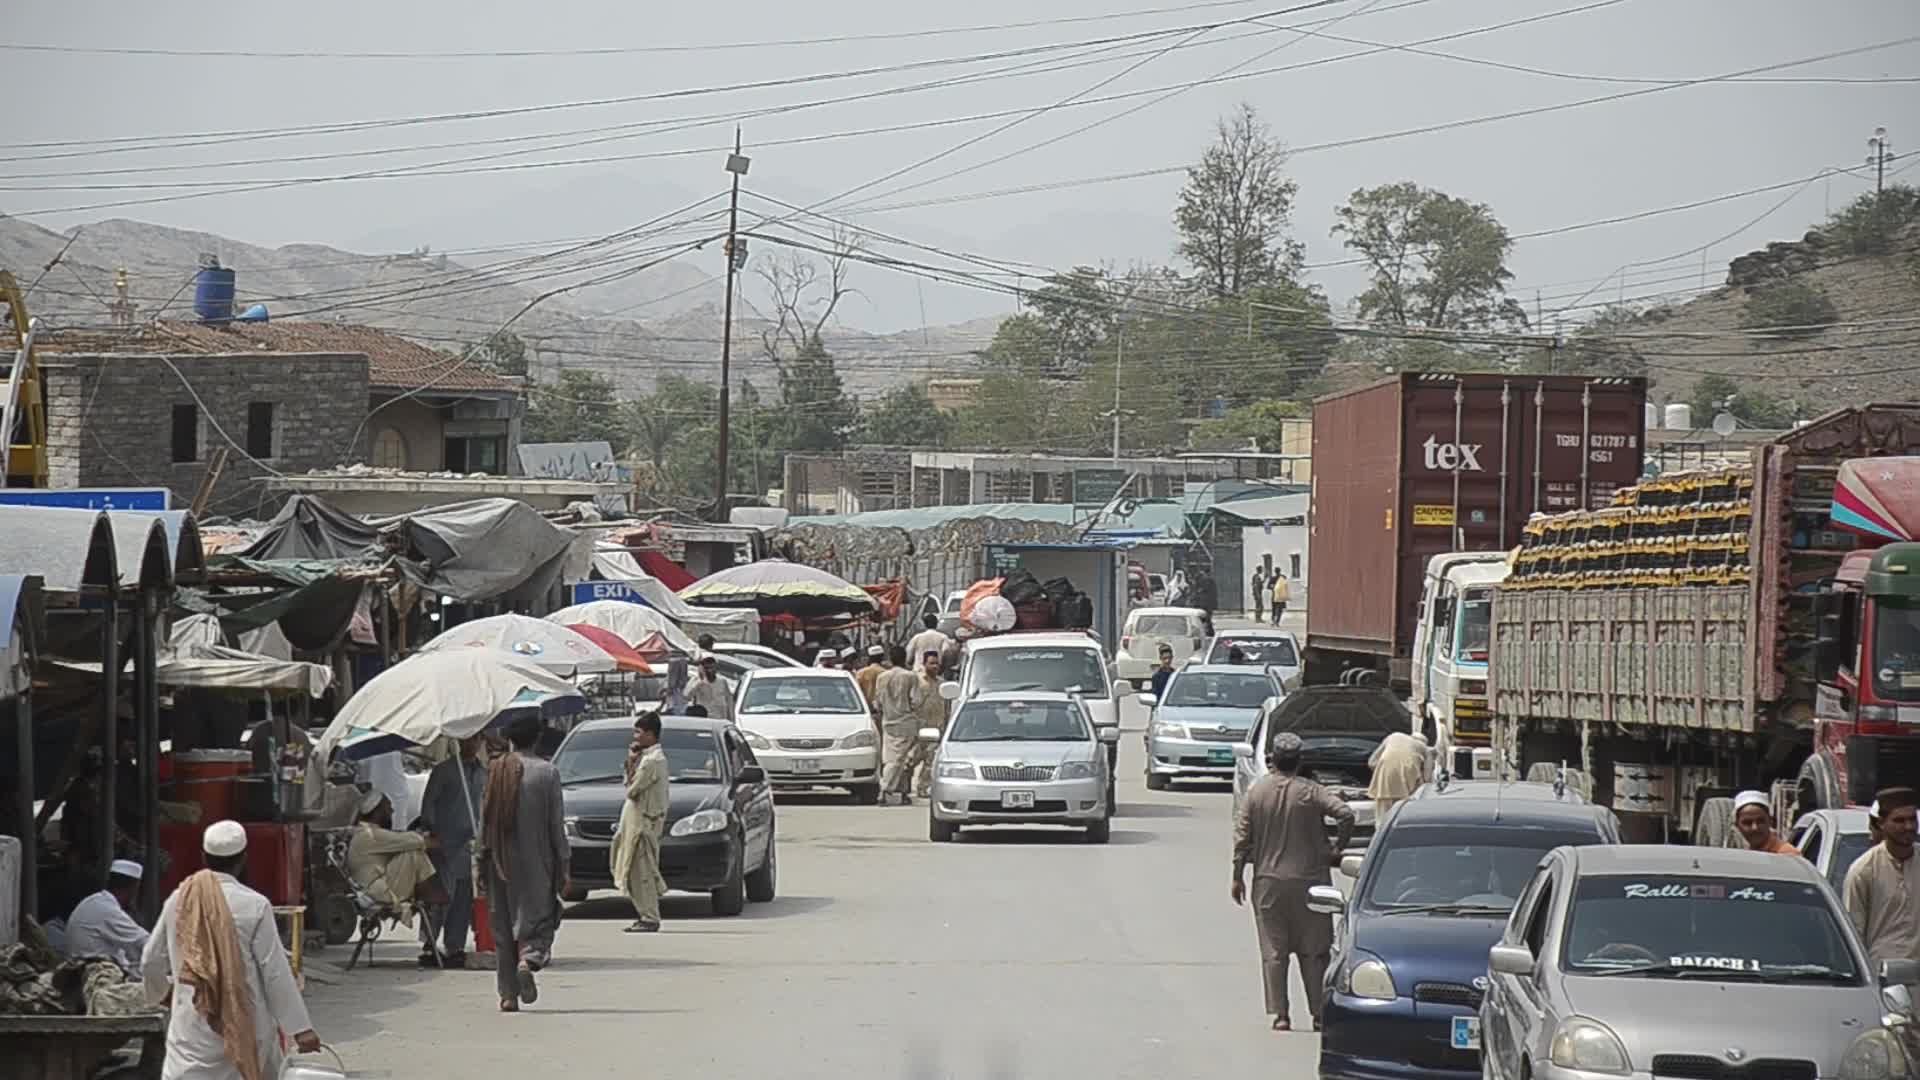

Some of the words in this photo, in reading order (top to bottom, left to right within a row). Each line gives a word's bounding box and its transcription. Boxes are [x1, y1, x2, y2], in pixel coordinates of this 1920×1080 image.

[1423, 434, 1484, 471] tex
[593, 584, 632, 598] EXIT
[1624, 884, 1688, 898] Ralli
[1729, 887, 1775, 901] Art
[1669, 956, 1744, 970] BALOCH
